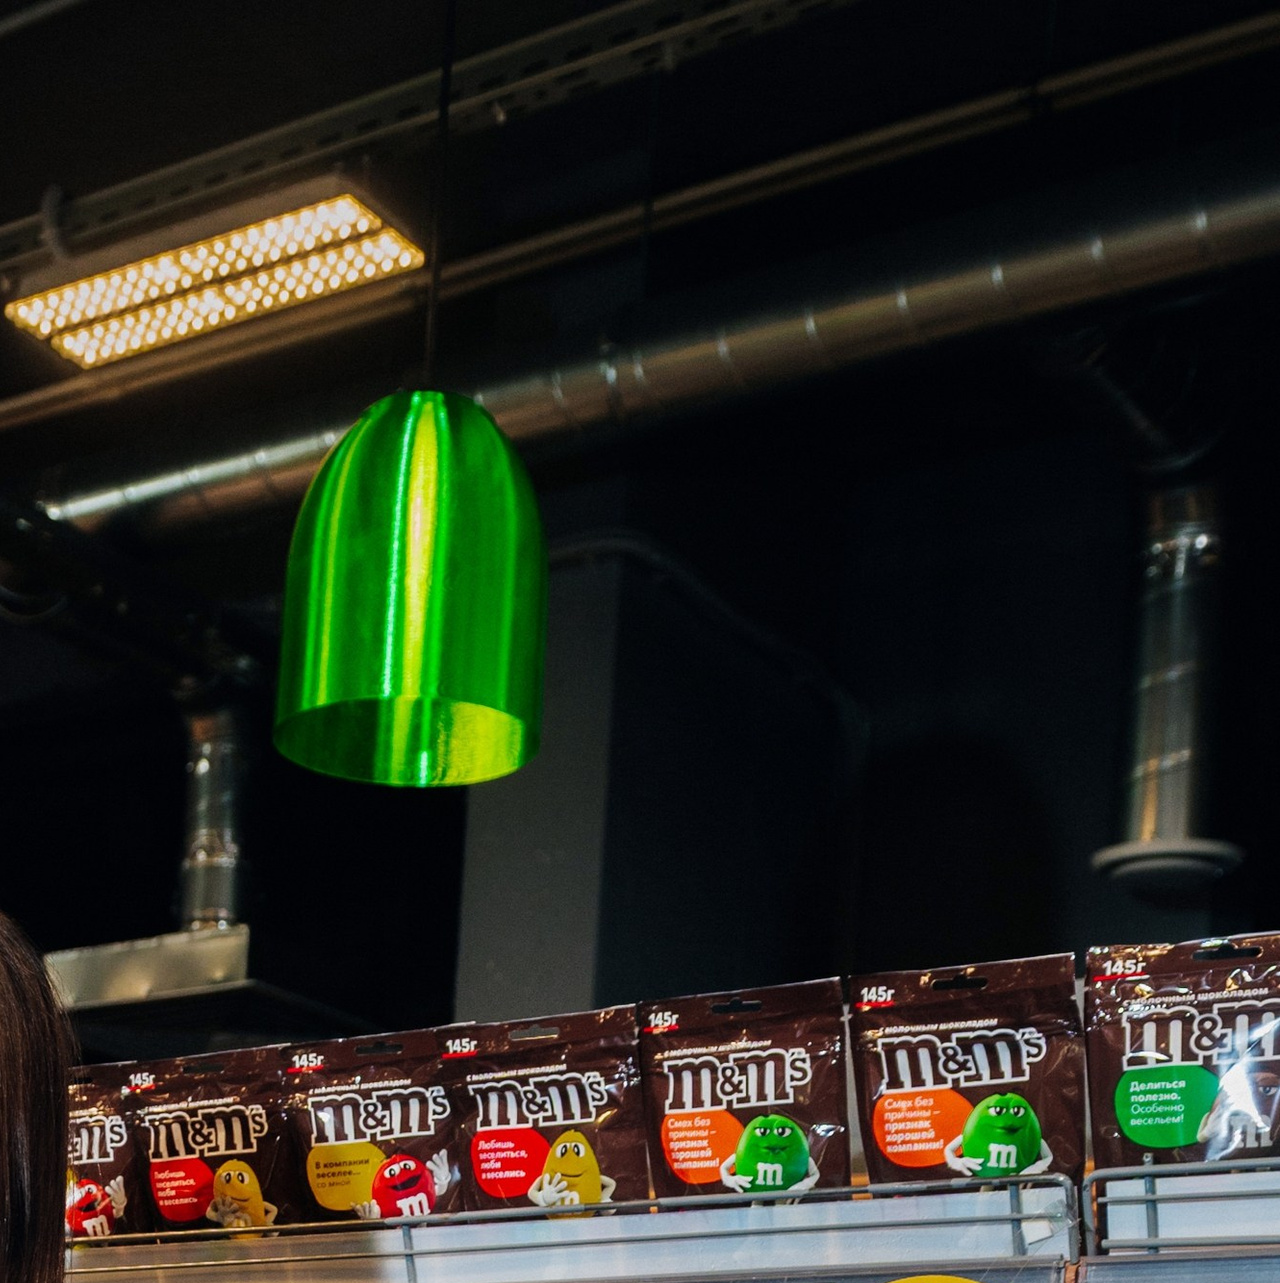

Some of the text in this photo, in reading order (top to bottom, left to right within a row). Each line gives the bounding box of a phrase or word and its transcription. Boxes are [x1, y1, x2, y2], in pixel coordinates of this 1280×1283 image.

[1102, 959, 1146, 976] 145г
[861, 987, 895, 1003] 145г
[648, 1012, 679, 1027] 145г
[446, 1038, 477, 1054] 145г
[292, 1053, 324, 1068] 145г
[877, 1027, 1047, 1095] m&m's
[663, 1048, 812, 1114] m&m's
[1130, 1081, 1186, 1093] Делиться
[468, 1072, 609, 1132] m&m's
[885, 1097, 934, 1109] Смех без
[1131, 1093, 1181, 1103] полезно.
[308, 1086, 451, 1147] m&m's
[1131, 1103, 1185, 1115] Особенно
[885, 1120, 931, 1131] признак
[1130, 1115, 1184, 1126] весельем!
[143, 1104, 268, 1162] m&m's
[886, 1130, 935, 1142] хорошей
